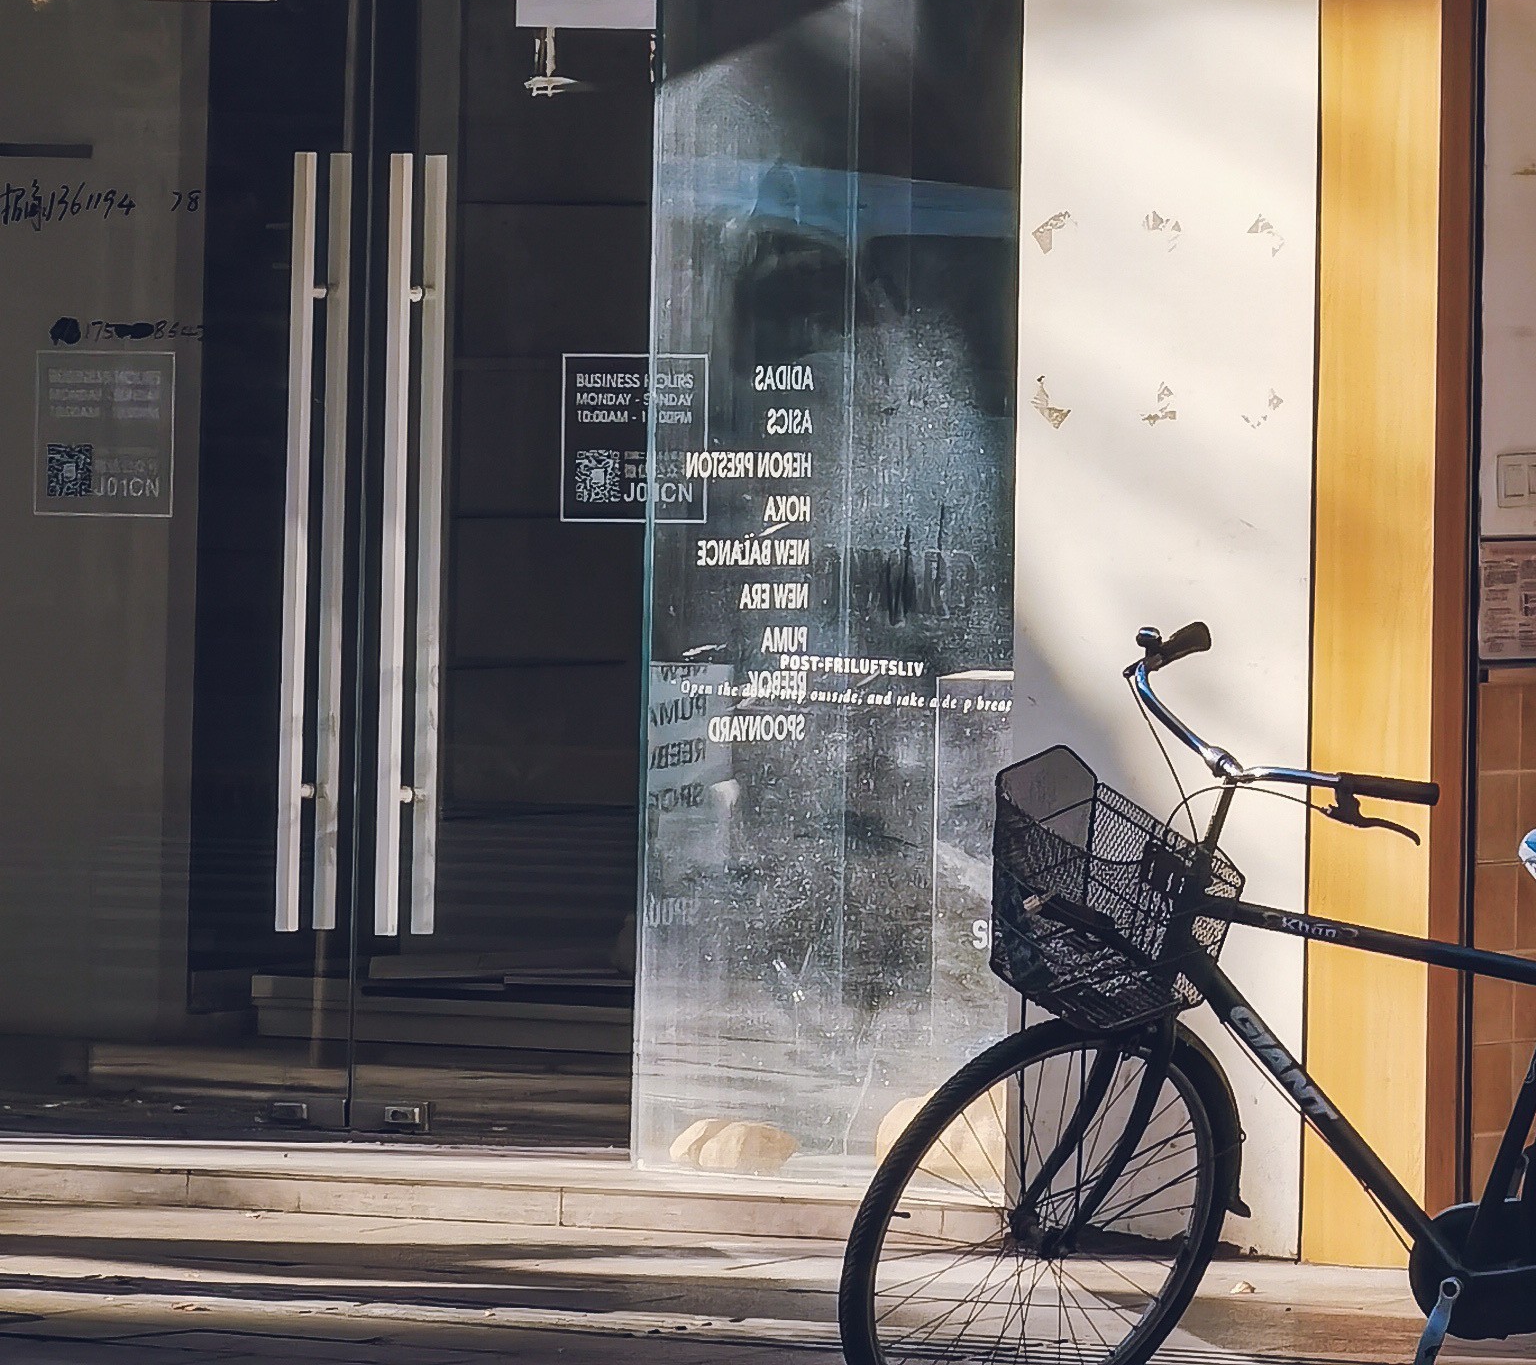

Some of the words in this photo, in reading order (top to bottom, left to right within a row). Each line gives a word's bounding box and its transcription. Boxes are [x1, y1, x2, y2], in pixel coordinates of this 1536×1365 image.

[576, 373, 640, 388] BUSINESS
[576, 393, 631, 405] MONDAY
[643, 393, 693, 406] SNDAY
[1230, 1005, 1339, 1120] GIANT
